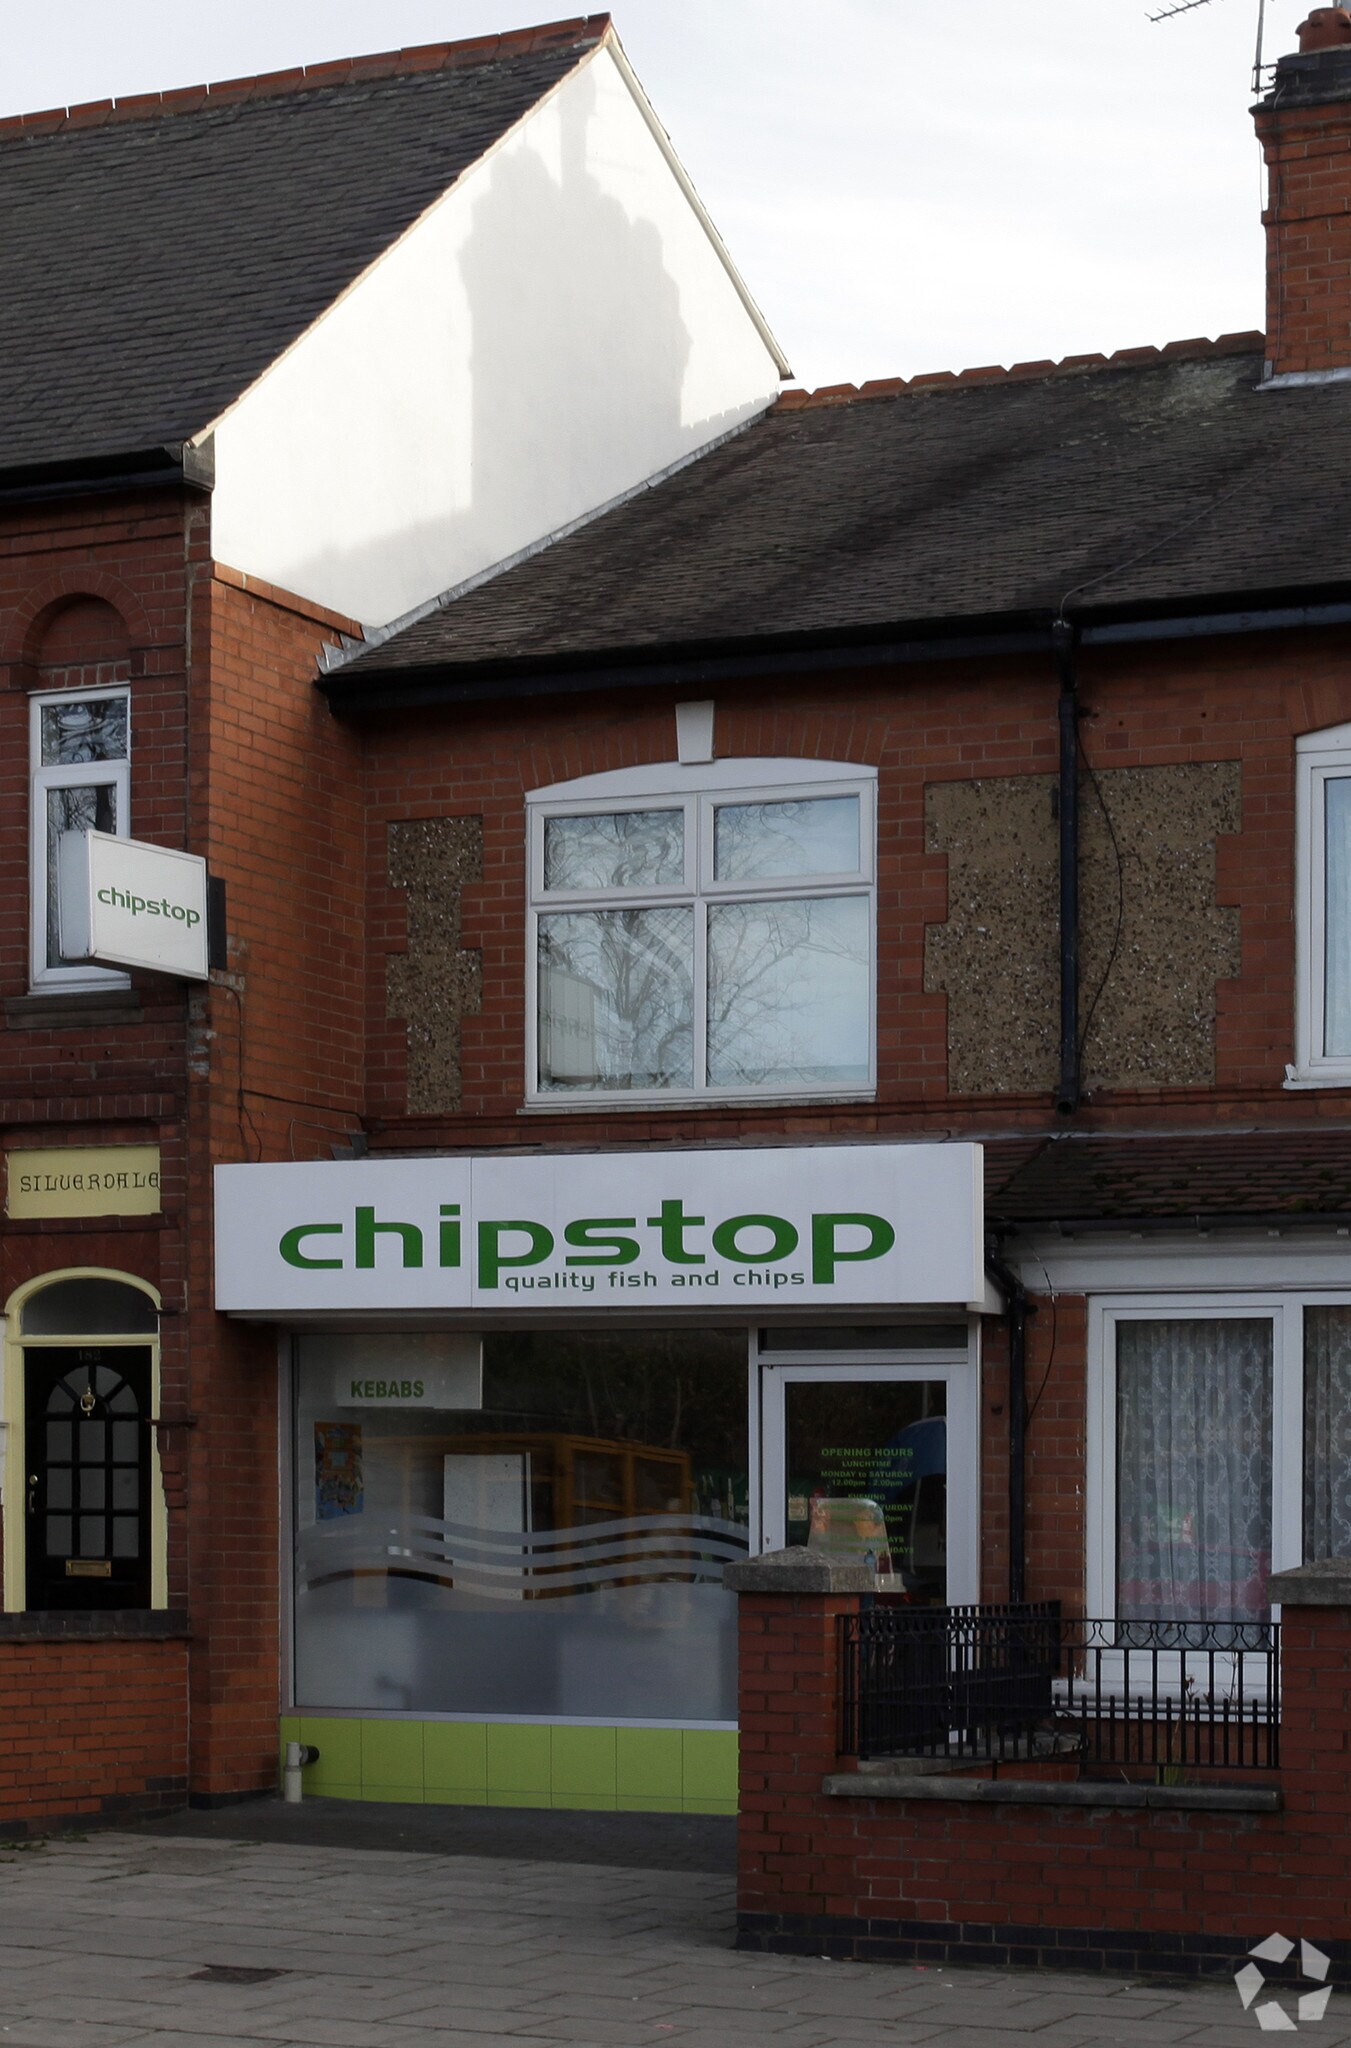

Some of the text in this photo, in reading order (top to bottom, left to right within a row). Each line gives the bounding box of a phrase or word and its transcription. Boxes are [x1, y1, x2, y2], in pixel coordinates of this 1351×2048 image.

[97, 886, 200, 928] chipstop
[279, 1199, 896, 1289] chipstop
[505, 1269, 805, 1292] quality fish and chips
[350, 1380, 424, 1398] KEBABS
[821, 1447, 914, 1457] OPENING HOURS
[832, 1479, 866, 1487] 12.00pm
